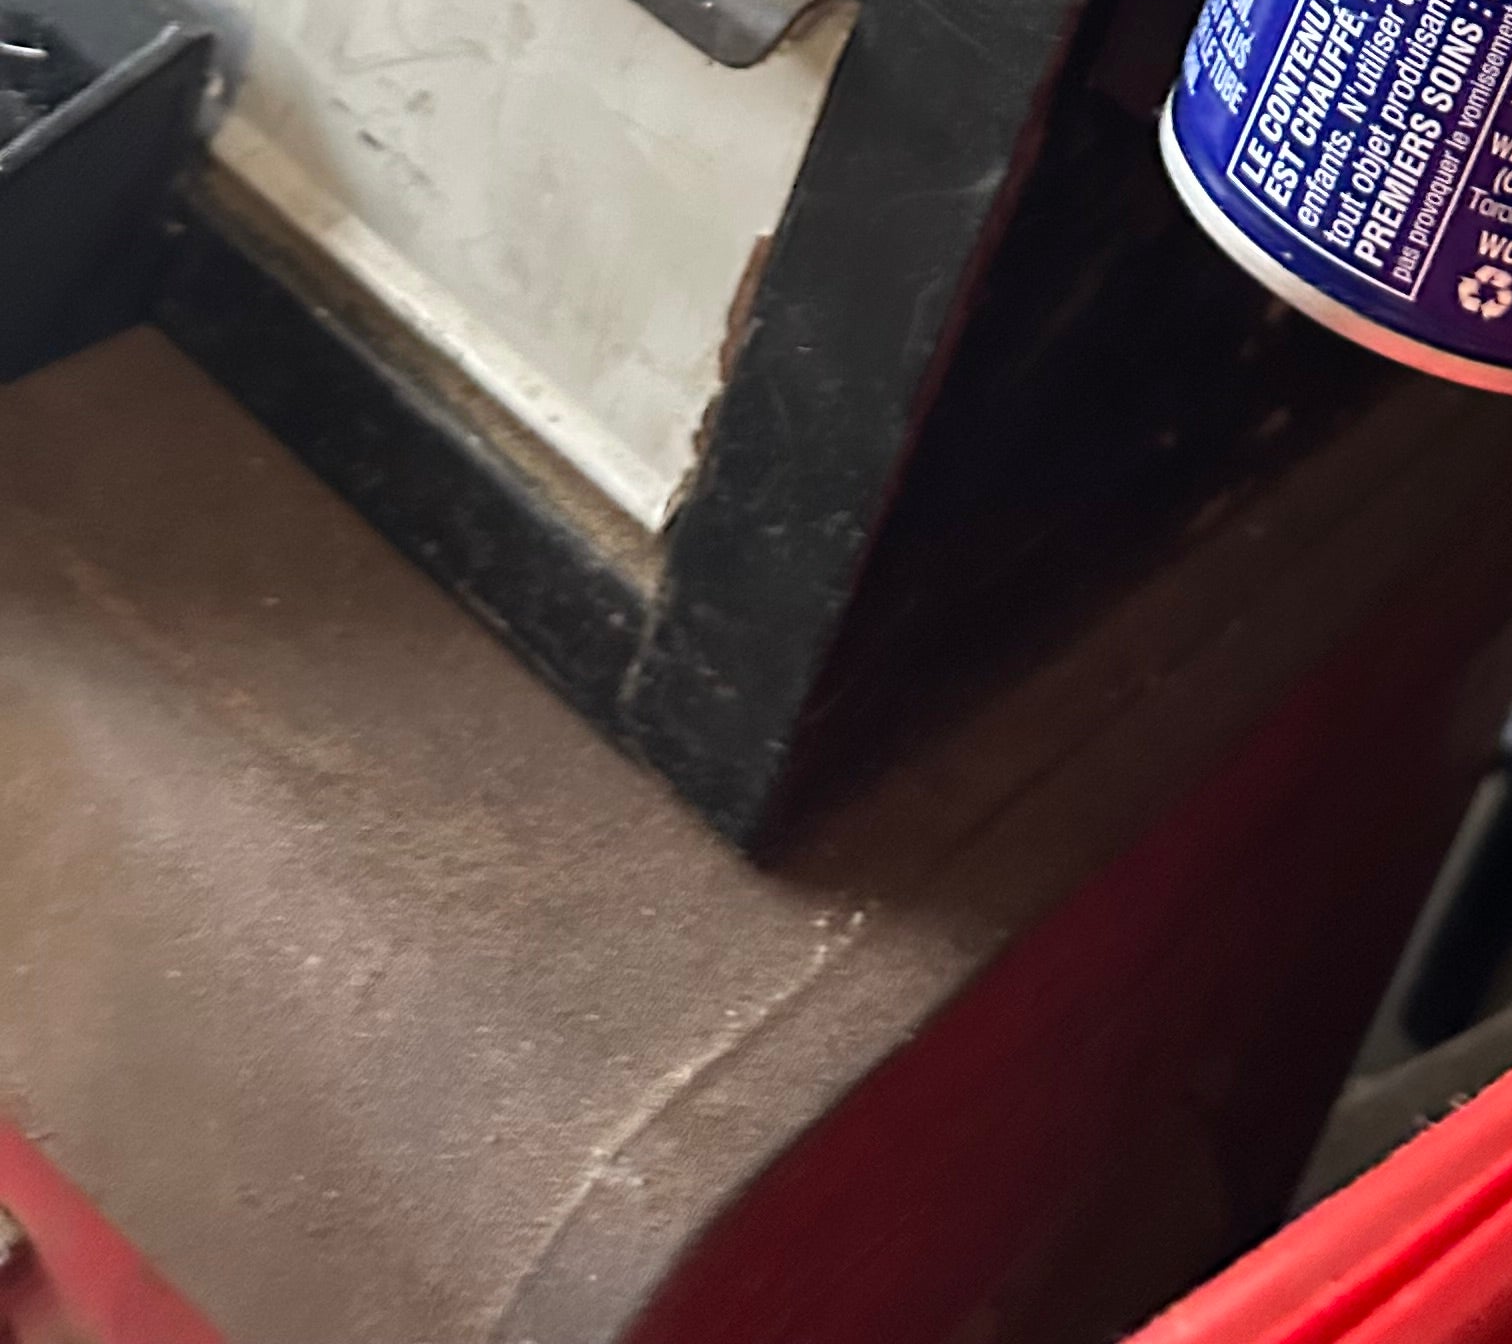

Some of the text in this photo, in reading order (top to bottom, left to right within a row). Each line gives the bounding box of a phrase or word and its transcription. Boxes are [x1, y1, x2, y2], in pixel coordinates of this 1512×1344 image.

[1240, 139, 1273, 186] LE
[1258, 0, 1340, 143] CONTENU
[1263, 142, 1305, 208] EST
[1289, 0, 1373, 147] CHAUFFÉ.
[1297, 129, 1357, 229] enfants.
[1336, 3, 1405, 124] N'utiliser
[1322, 191, 1367, 248] tout
[1351, 123, 1396, 194] objet
[1354, 112, 1442, 268] PREMIERS
[1421, 16, 1484, 113] SOINS
[1391, 245, 1421, 284] pas
[1407, 149, 1461, 248] provoquer
[1444, 130, 1471, 151] le
